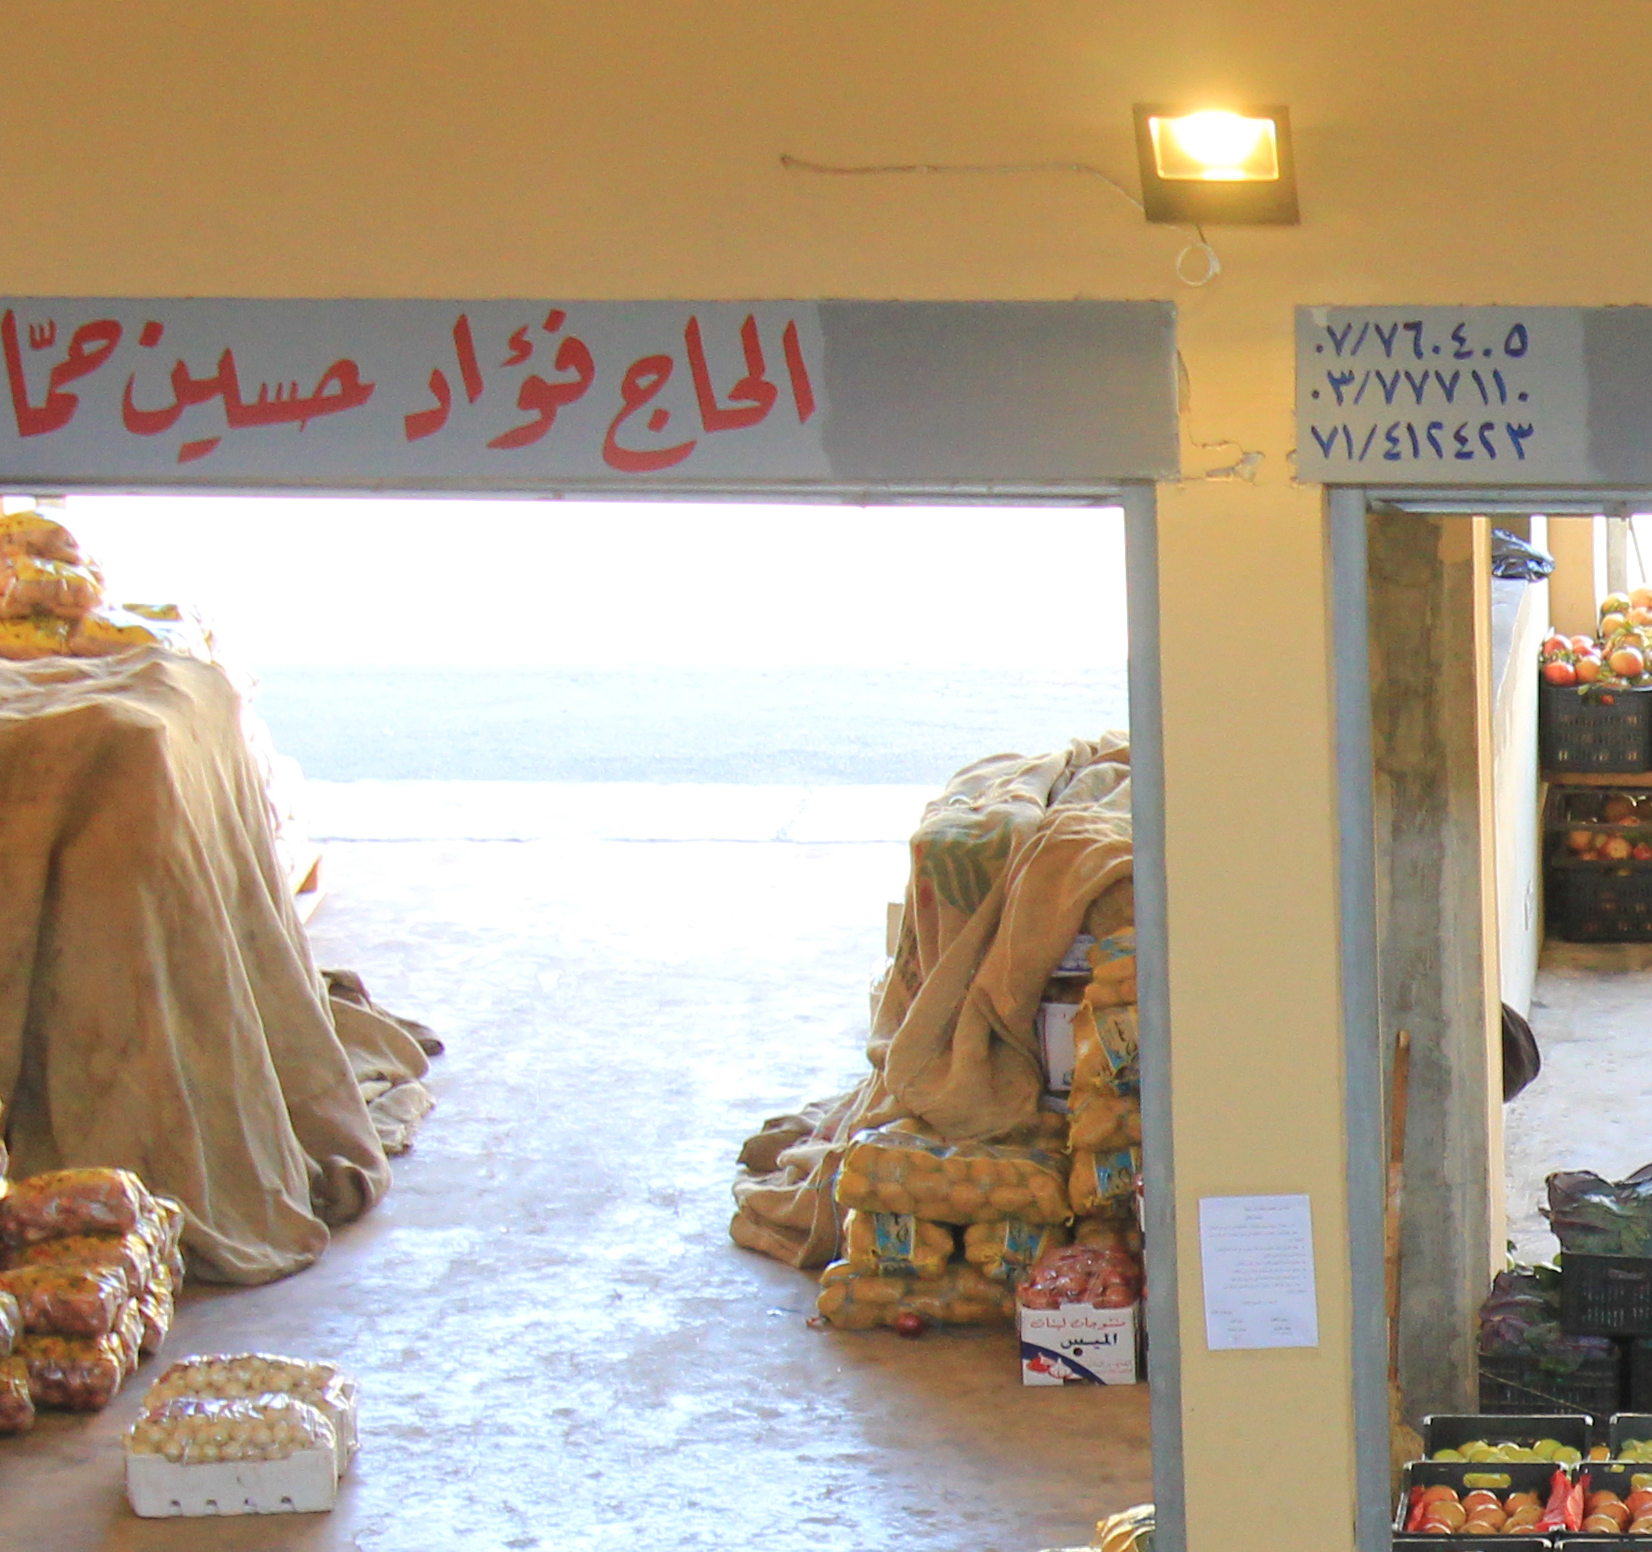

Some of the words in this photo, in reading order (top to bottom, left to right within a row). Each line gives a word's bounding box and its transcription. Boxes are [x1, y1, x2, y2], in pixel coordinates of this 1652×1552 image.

[123, 322, 374, 462] حسين
[406, 310, 594, 448] فؤاد
[604, 311, 815, 472] الحاج
